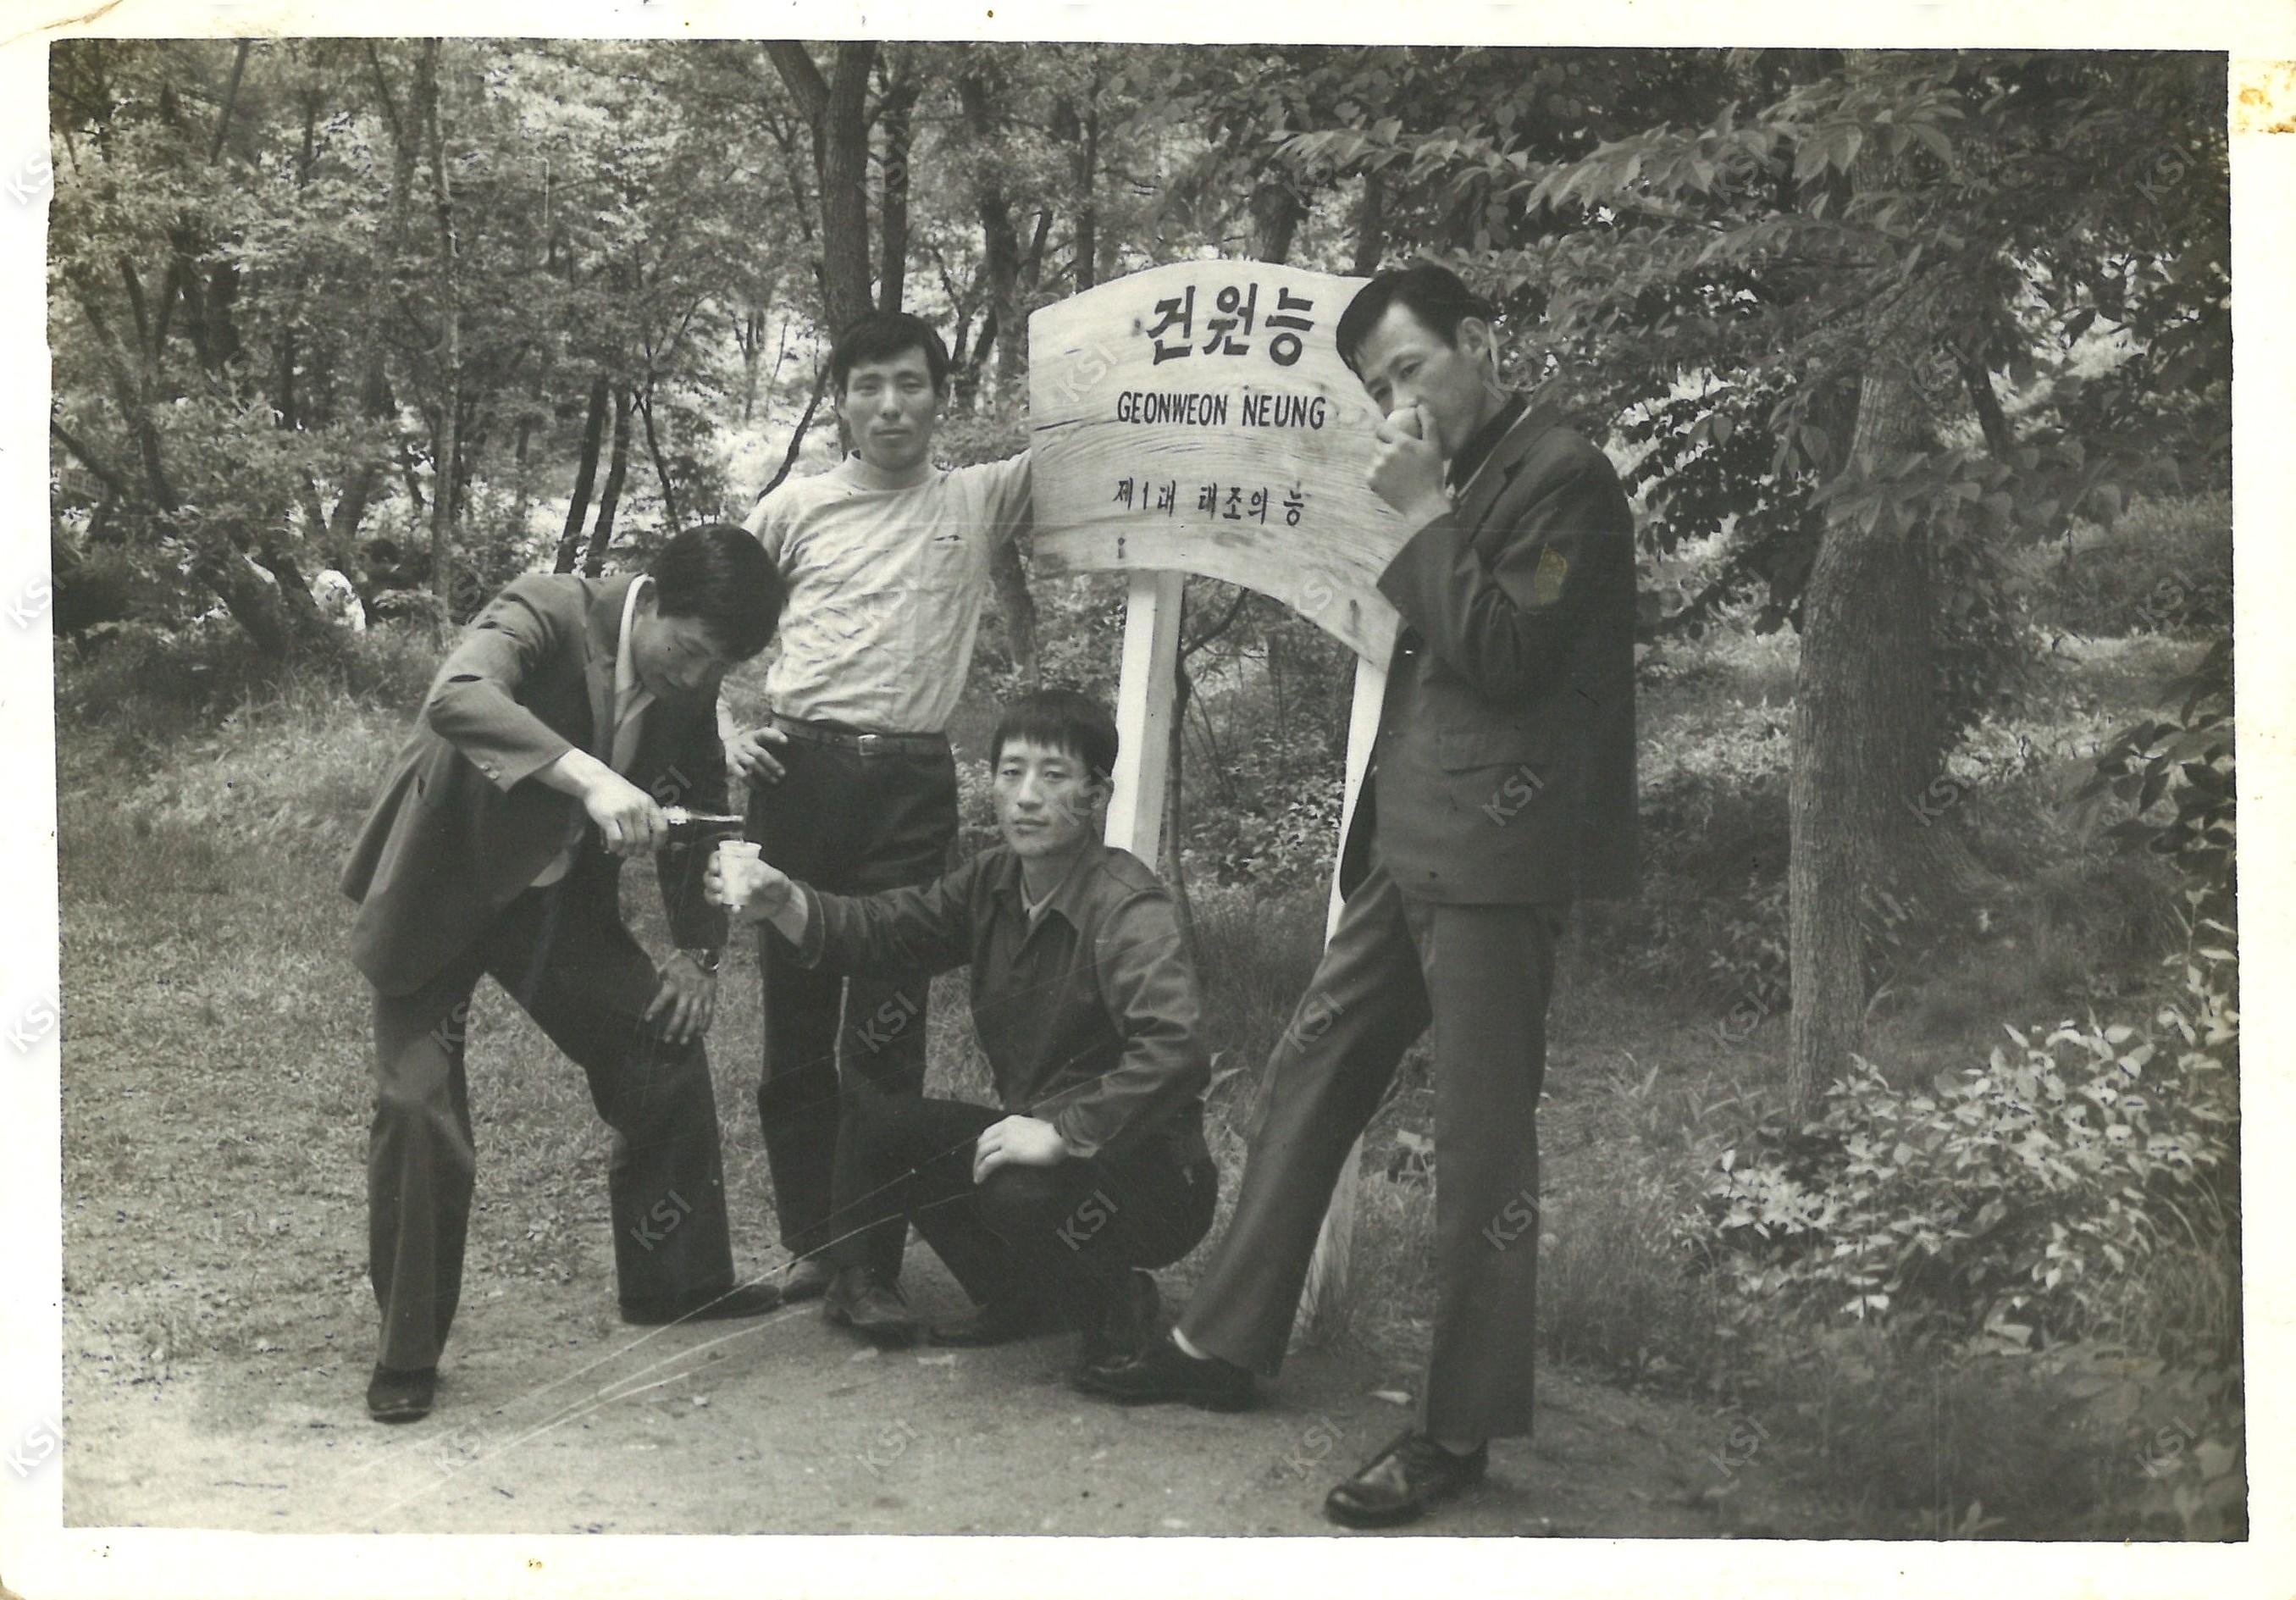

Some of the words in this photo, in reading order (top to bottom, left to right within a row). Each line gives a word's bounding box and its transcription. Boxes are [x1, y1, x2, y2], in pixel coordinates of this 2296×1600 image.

[1146, 282, 1315, 367] 건원능
[1117, 390, 1229, 426] GEONWEON
[1242, 394, 1326, 430] NEUNG
